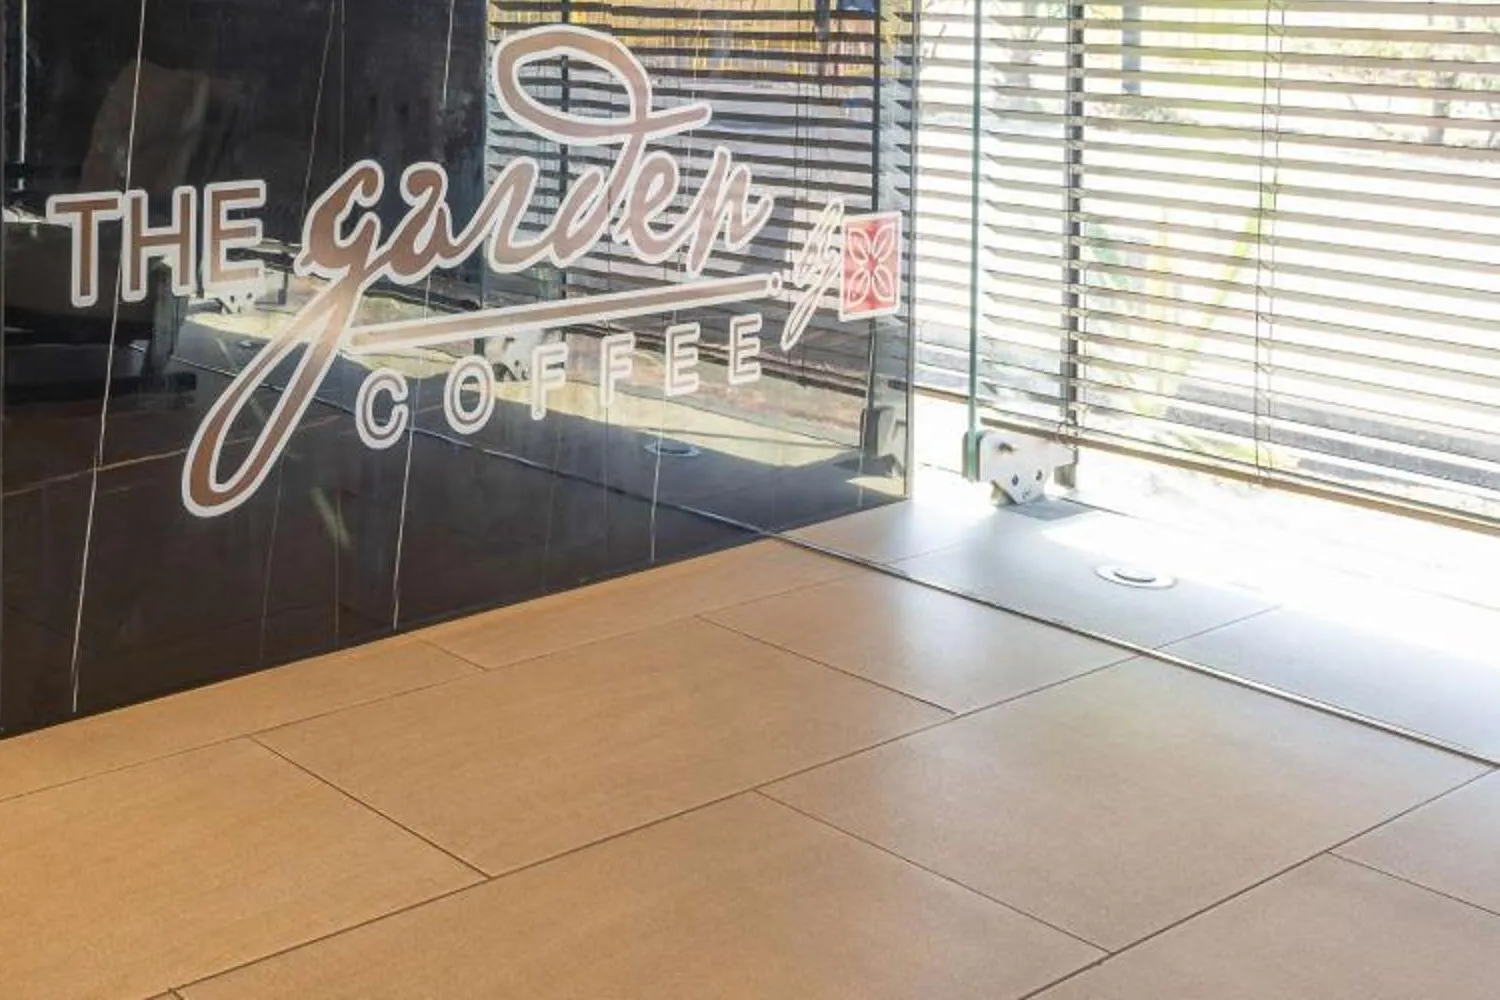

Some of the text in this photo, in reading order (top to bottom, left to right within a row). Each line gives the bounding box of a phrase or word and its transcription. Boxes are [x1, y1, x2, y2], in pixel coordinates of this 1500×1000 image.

[48, 23, 774, 518] THE garden
[355, 312, 764, 451] COFFEE
